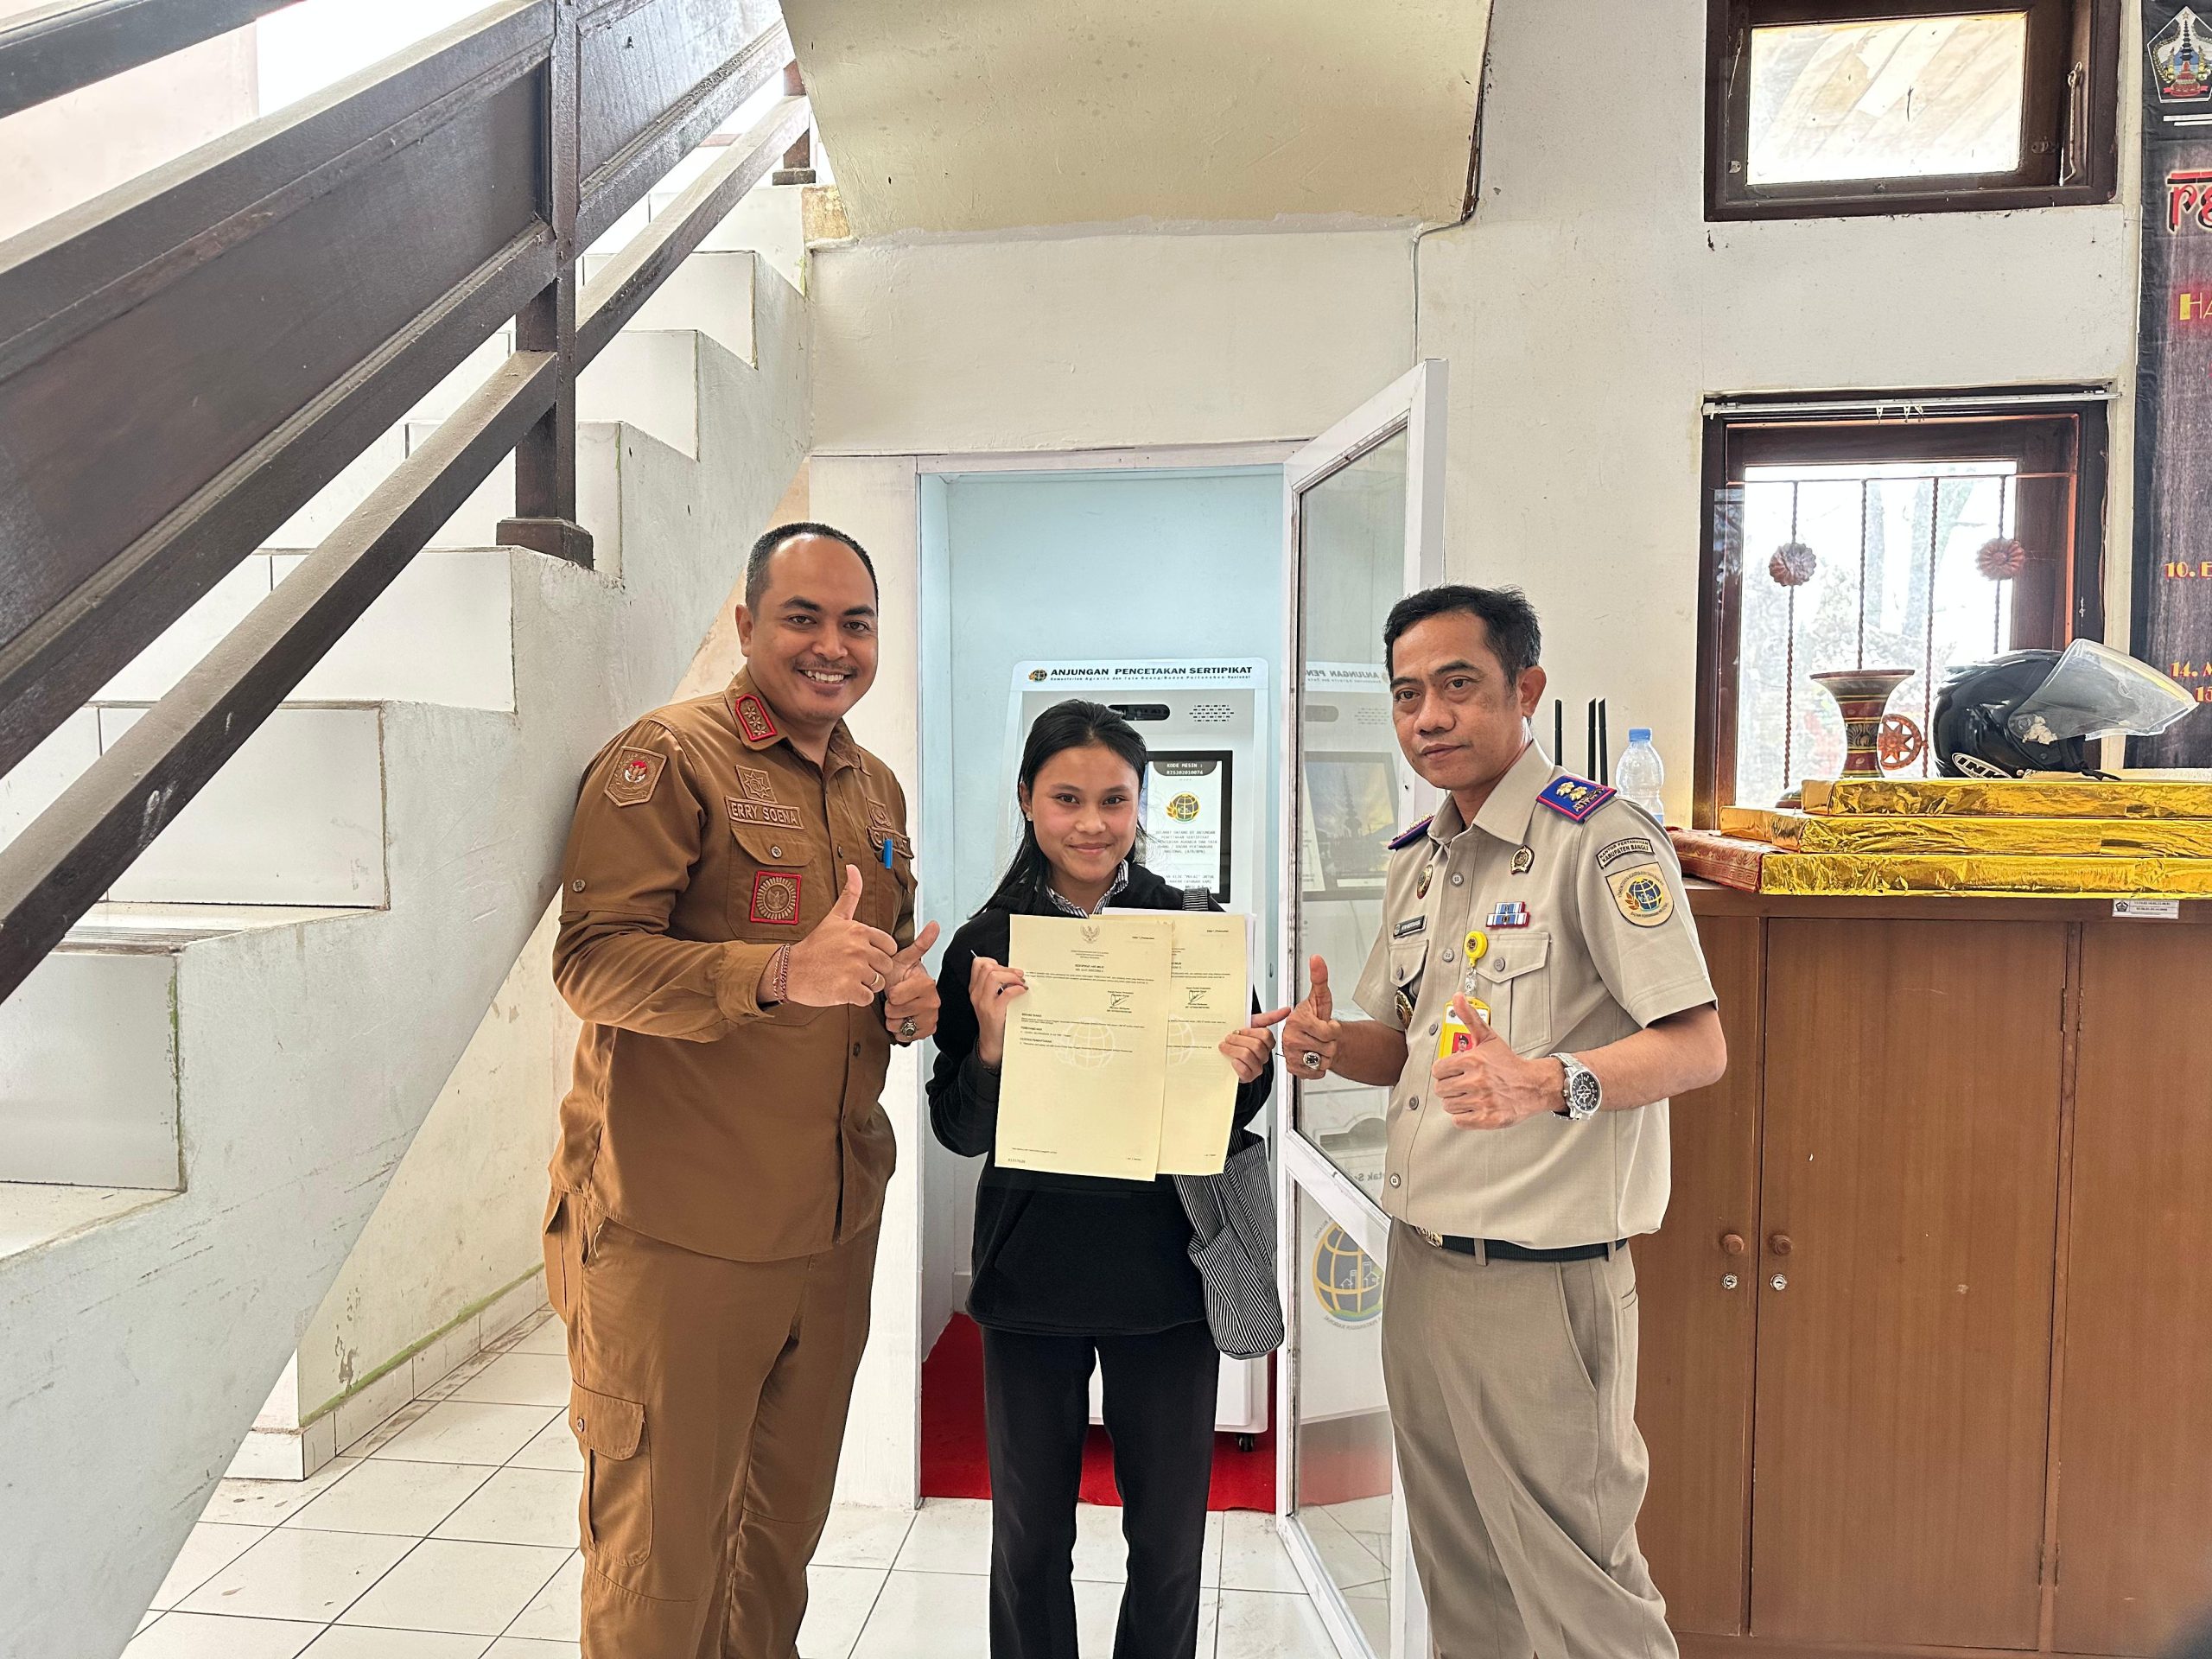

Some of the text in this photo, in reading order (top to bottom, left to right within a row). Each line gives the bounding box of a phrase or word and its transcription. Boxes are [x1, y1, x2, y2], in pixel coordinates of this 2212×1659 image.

[2164, 562, 2196, 578] 10.
[2171, 660, 2198, 677] 14.
[731, 802, 799, 825] ERRY SOENA
[1599, 845, 1617, 858] KANTOR
[1601, 846, 1631, 863] KABUPATEN
